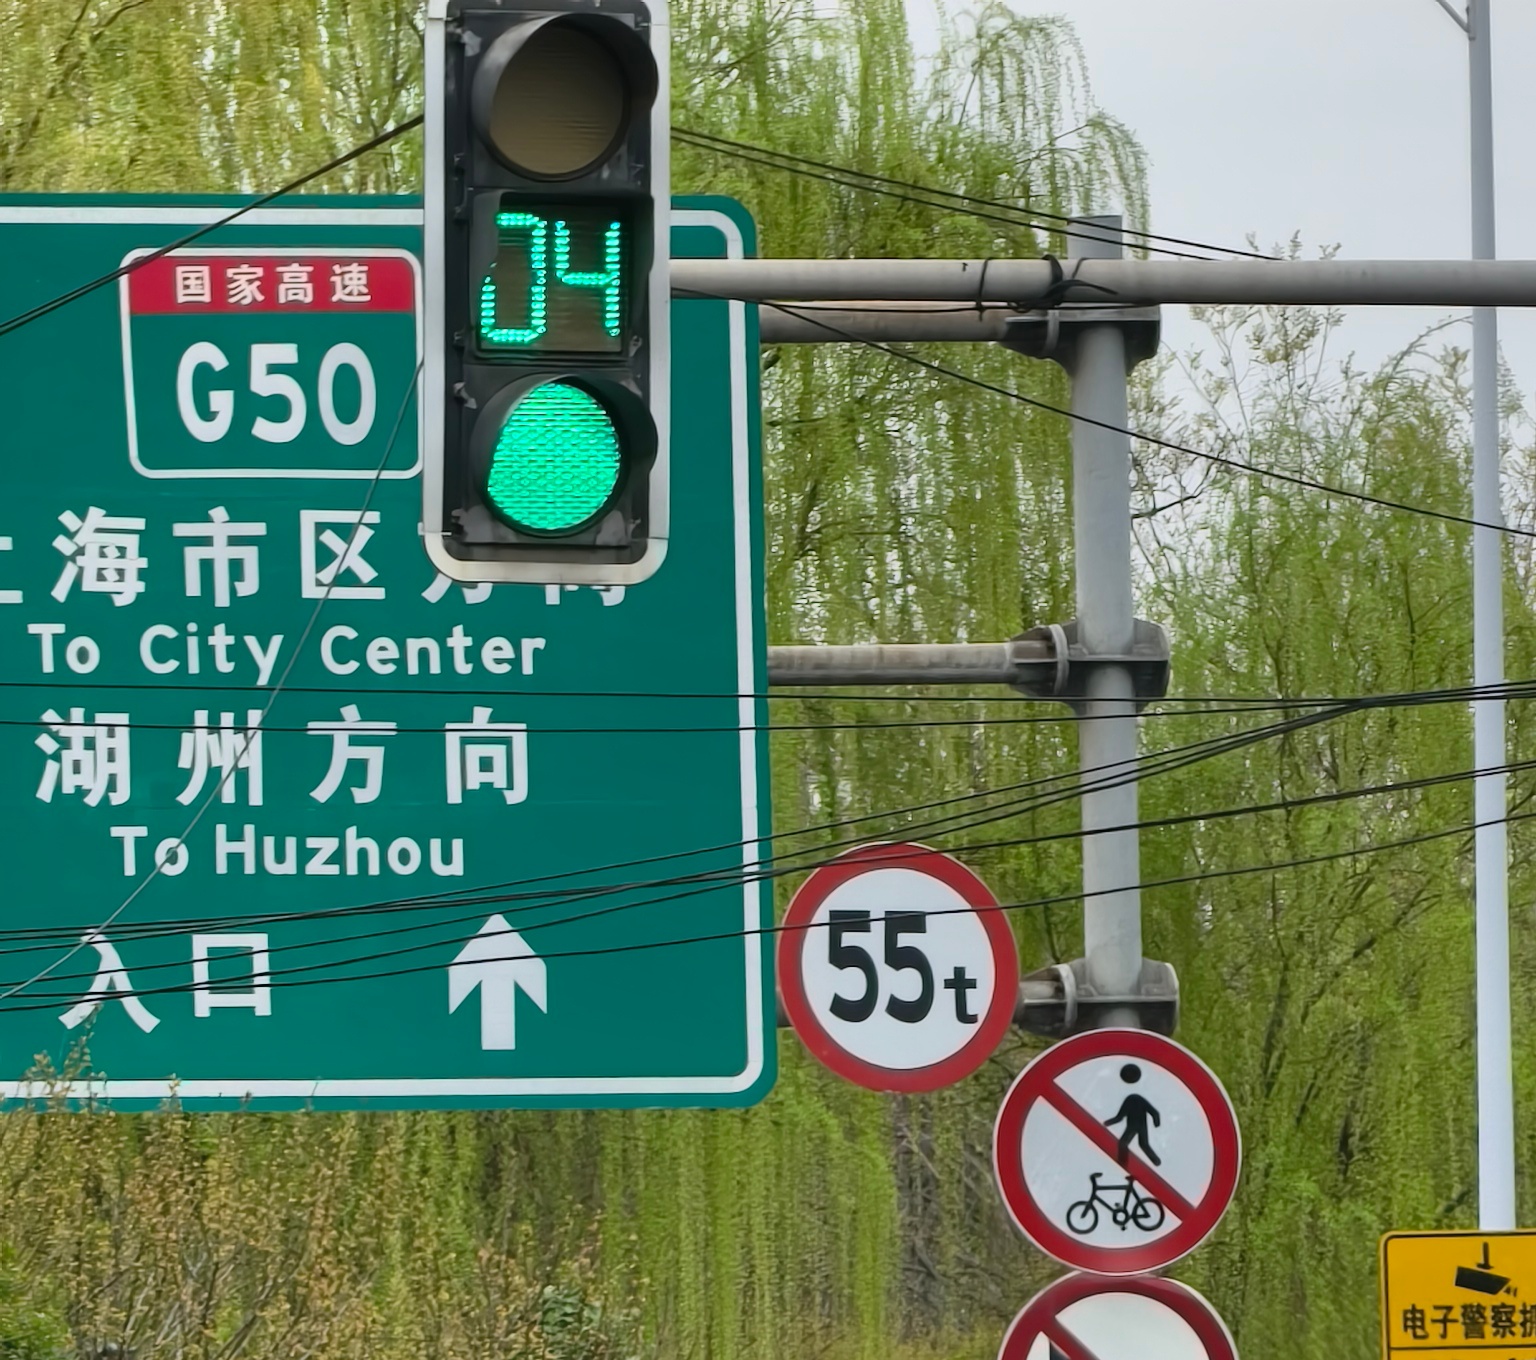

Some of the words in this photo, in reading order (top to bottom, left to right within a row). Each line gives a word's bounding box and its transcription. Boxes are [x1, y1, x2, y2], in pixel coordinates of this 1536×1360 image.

[174, 263, 373, 305] 国家高速
[176, 341, 376, 446] G50
[27, 622, 100, 675] To
[139, 622, 284, 686] City
[320, 624, 547, 676] Center
[34, 704, 529, 807] 湖州方向
[110, 826, 189, 876] To
[214, 823, 465, 877] Huzhou
[58, 928, 272, 1034] 入口
[827, 910, 979, 1024] 55t
